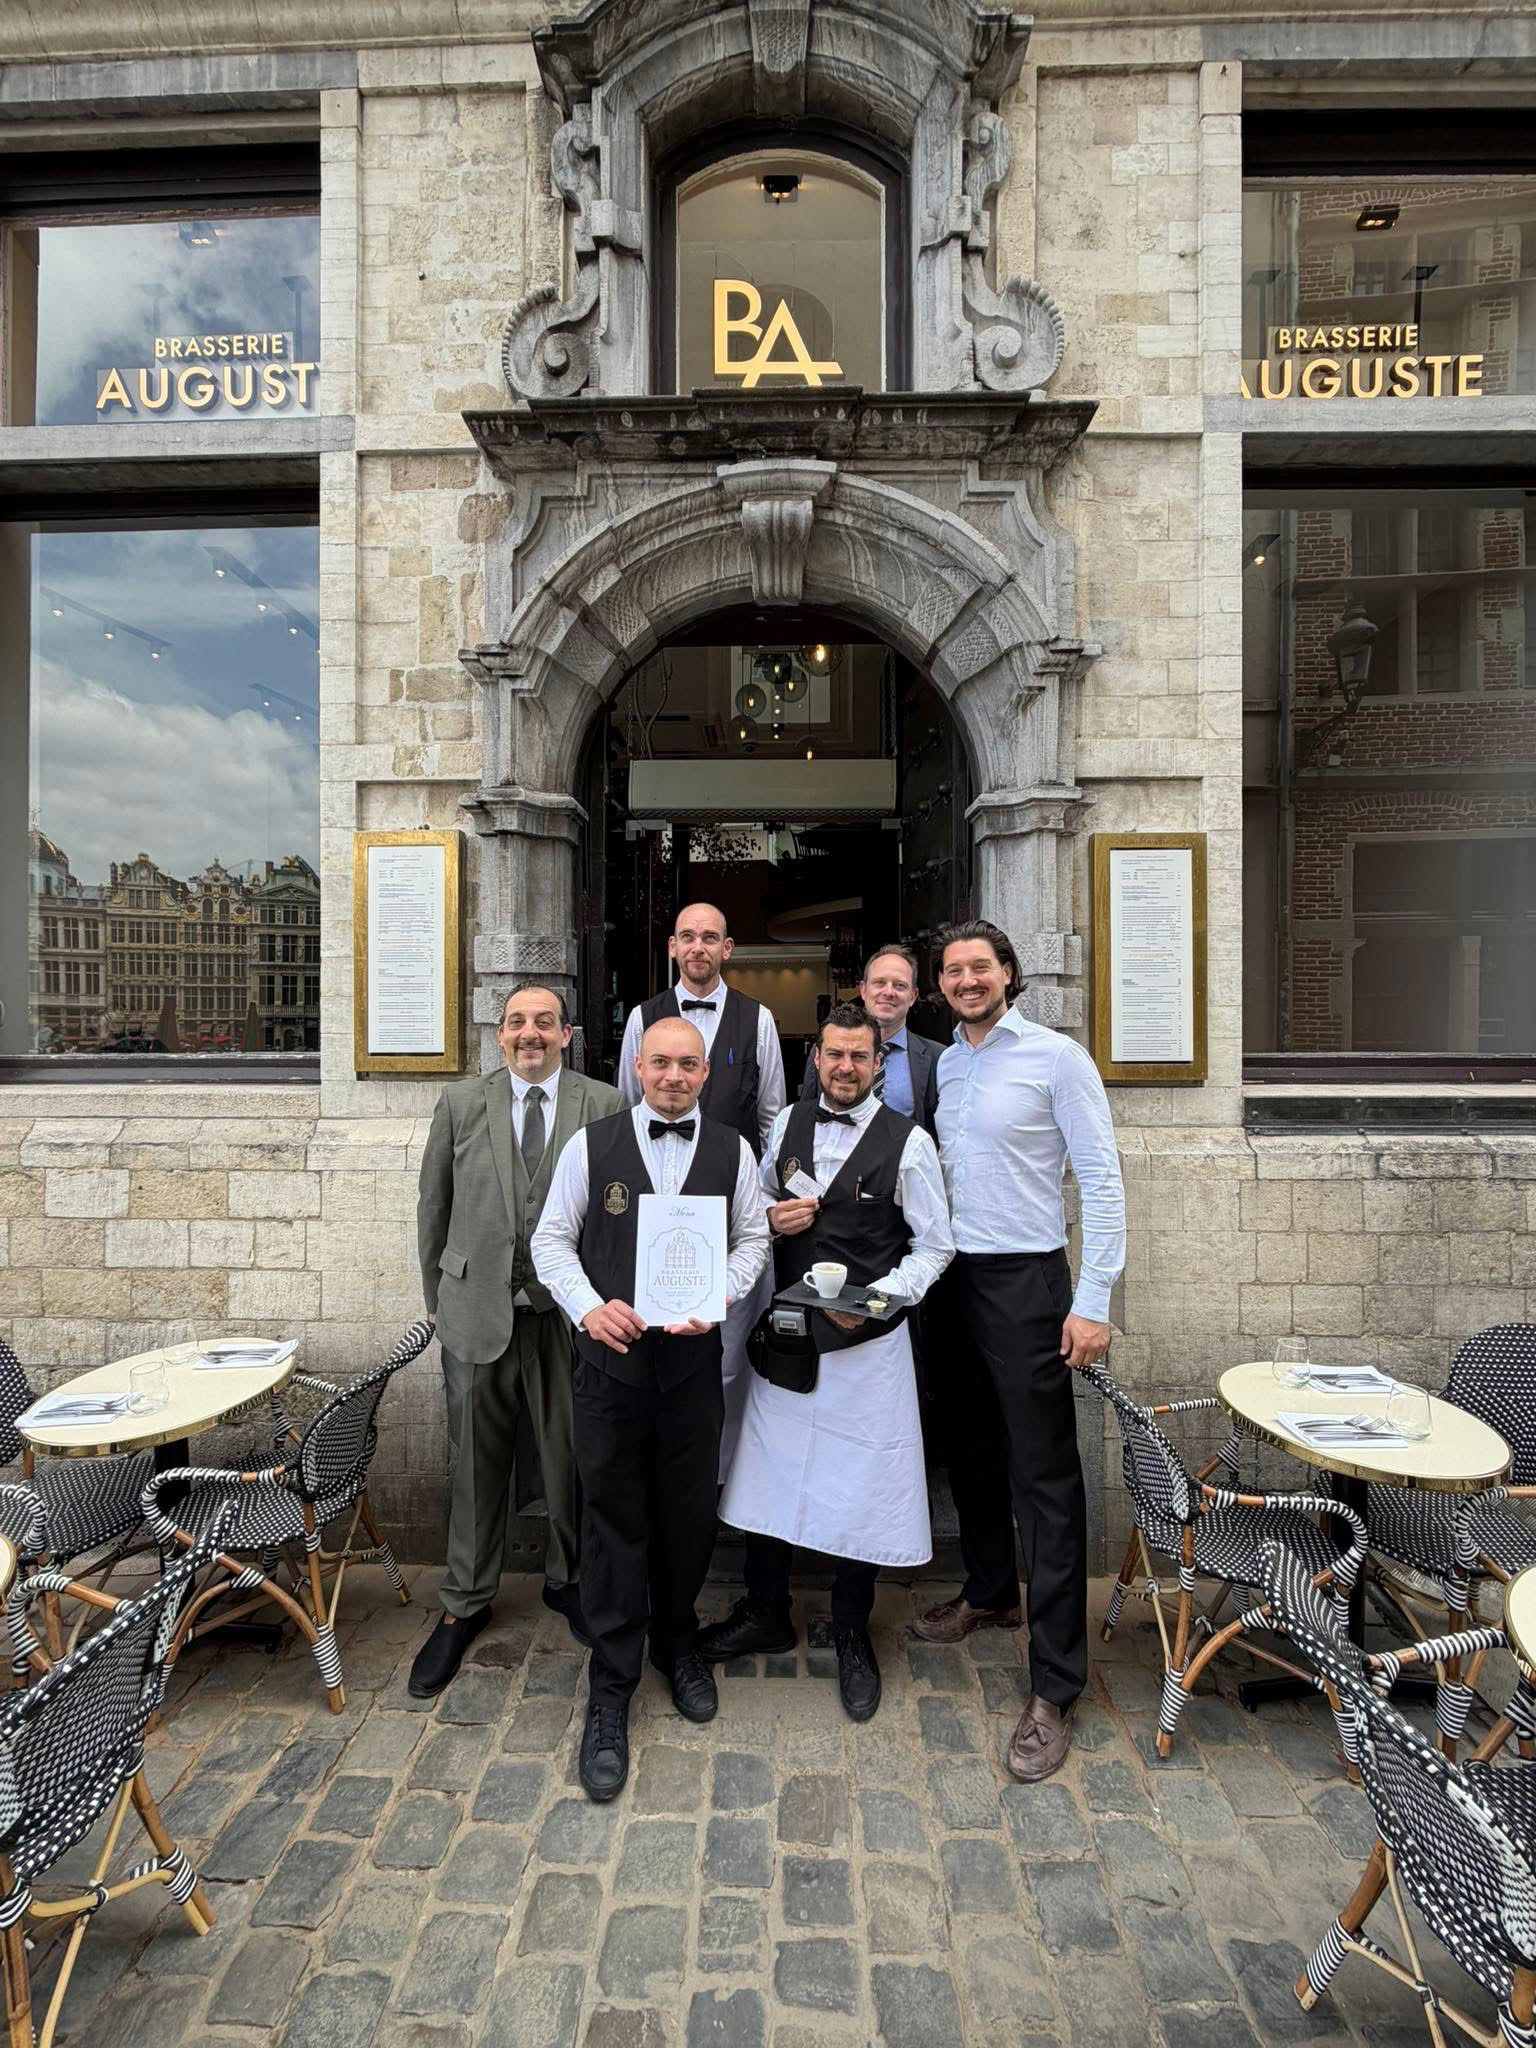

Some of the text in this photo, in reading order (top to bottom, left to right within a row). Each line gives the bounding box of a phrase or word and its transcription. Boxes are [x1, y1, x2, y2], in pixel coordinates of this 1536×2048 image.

[154, 333, 284, 358] BRASSERIE
[1279, 325, 1418, 349] BRASSERIE
[96, 362, 318, 410] AUGUST
[1240, 354, 1484, 400] UGUSTE
[653, 1275, 707, 1287] AUGUSTE
